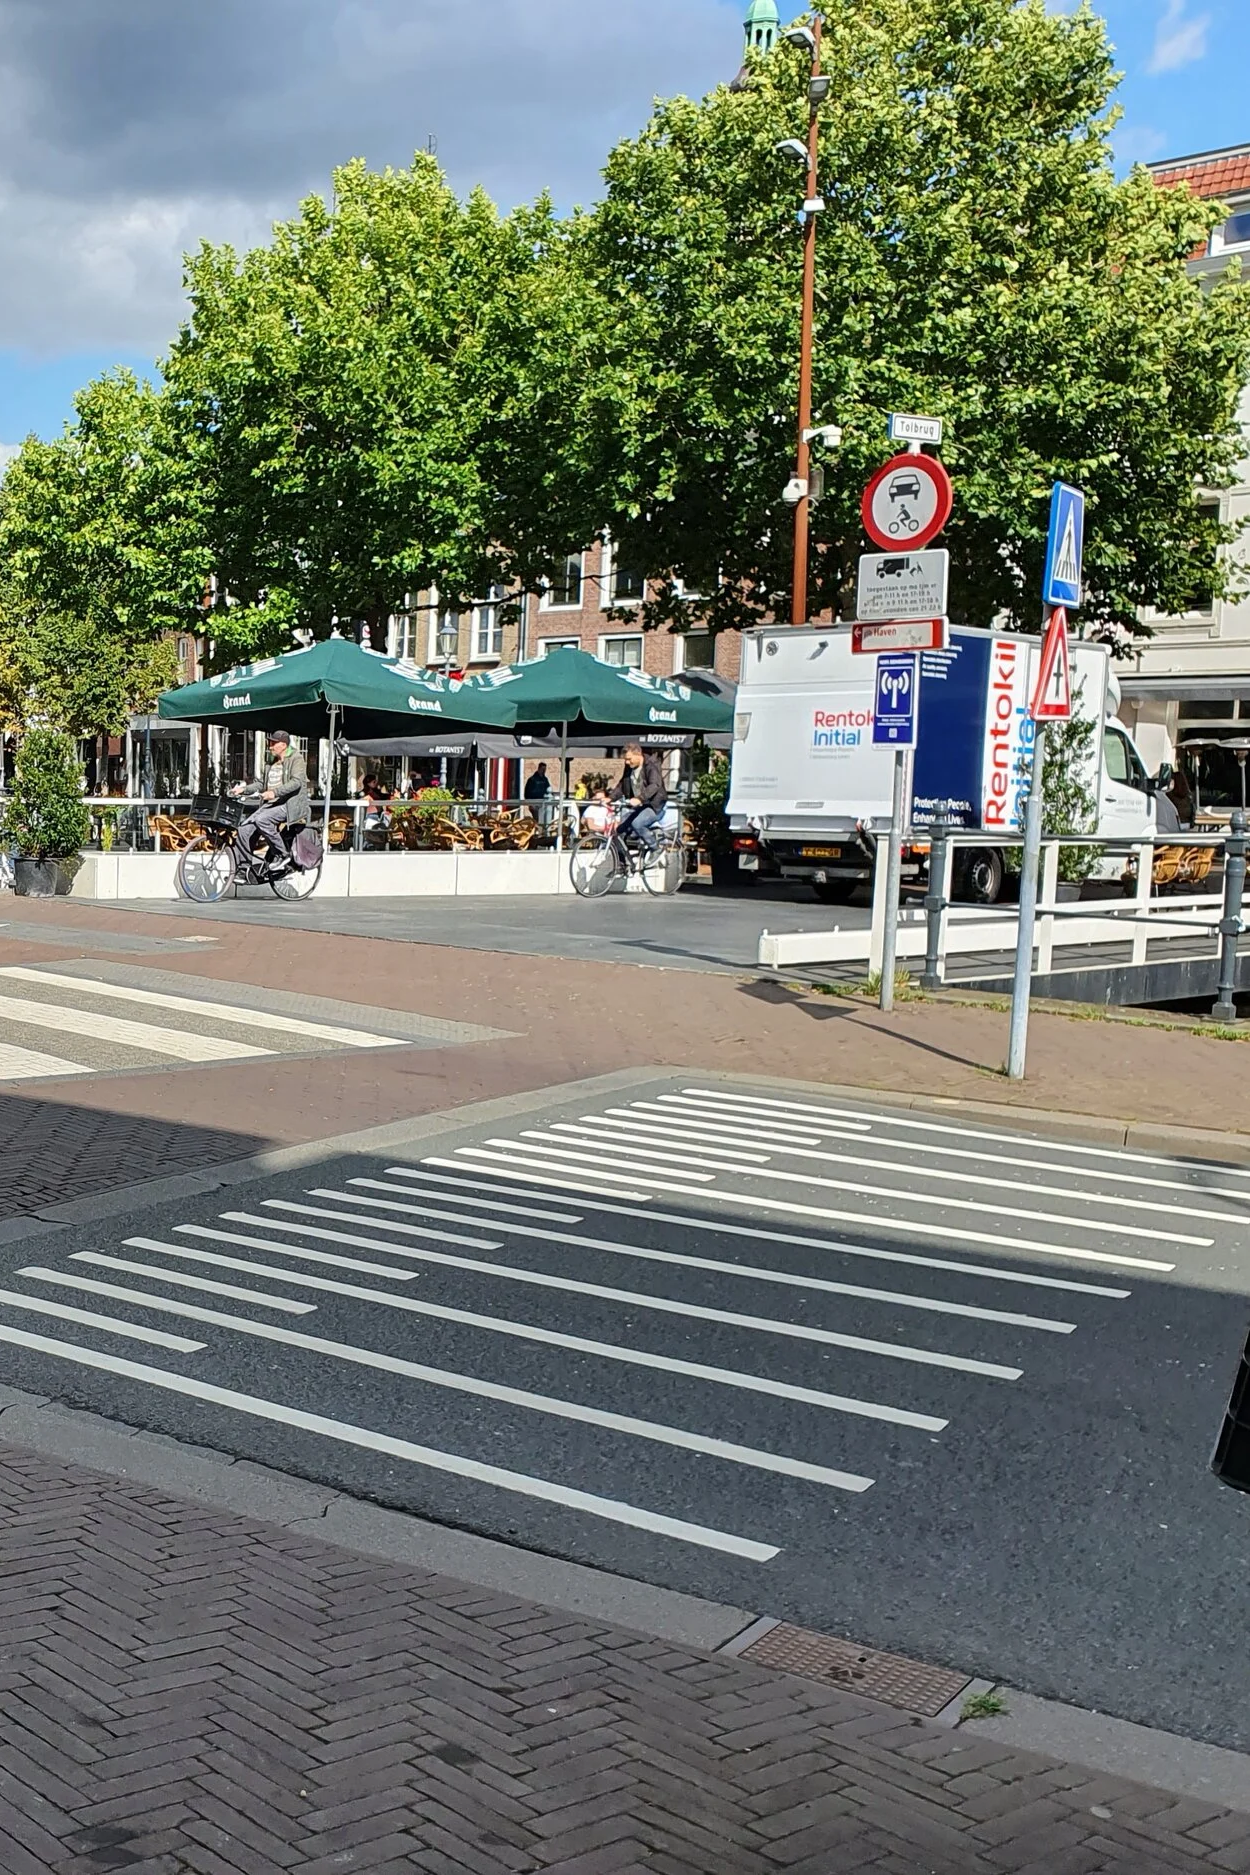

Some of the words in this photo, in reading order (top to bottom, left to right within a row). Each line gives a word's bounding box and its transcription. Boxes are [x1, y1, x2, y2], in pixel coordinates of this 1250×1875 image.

[900, 420, 935, 437] Tolbrug
[874, 628, 897, 636] Haven
[223, 693, 252, 710] Brand
[408, 695, 443, 712] Brand
[649, 706, 678, 723] Brand
[814, 709, 874, 728] Rentok
[647, 734, 687, 743] BOTANIST
[813, 729, 861, 746] Initial
[984, 642, 1017, 825] Rentokil
[435, 745, 465, 754] BOTANIST
